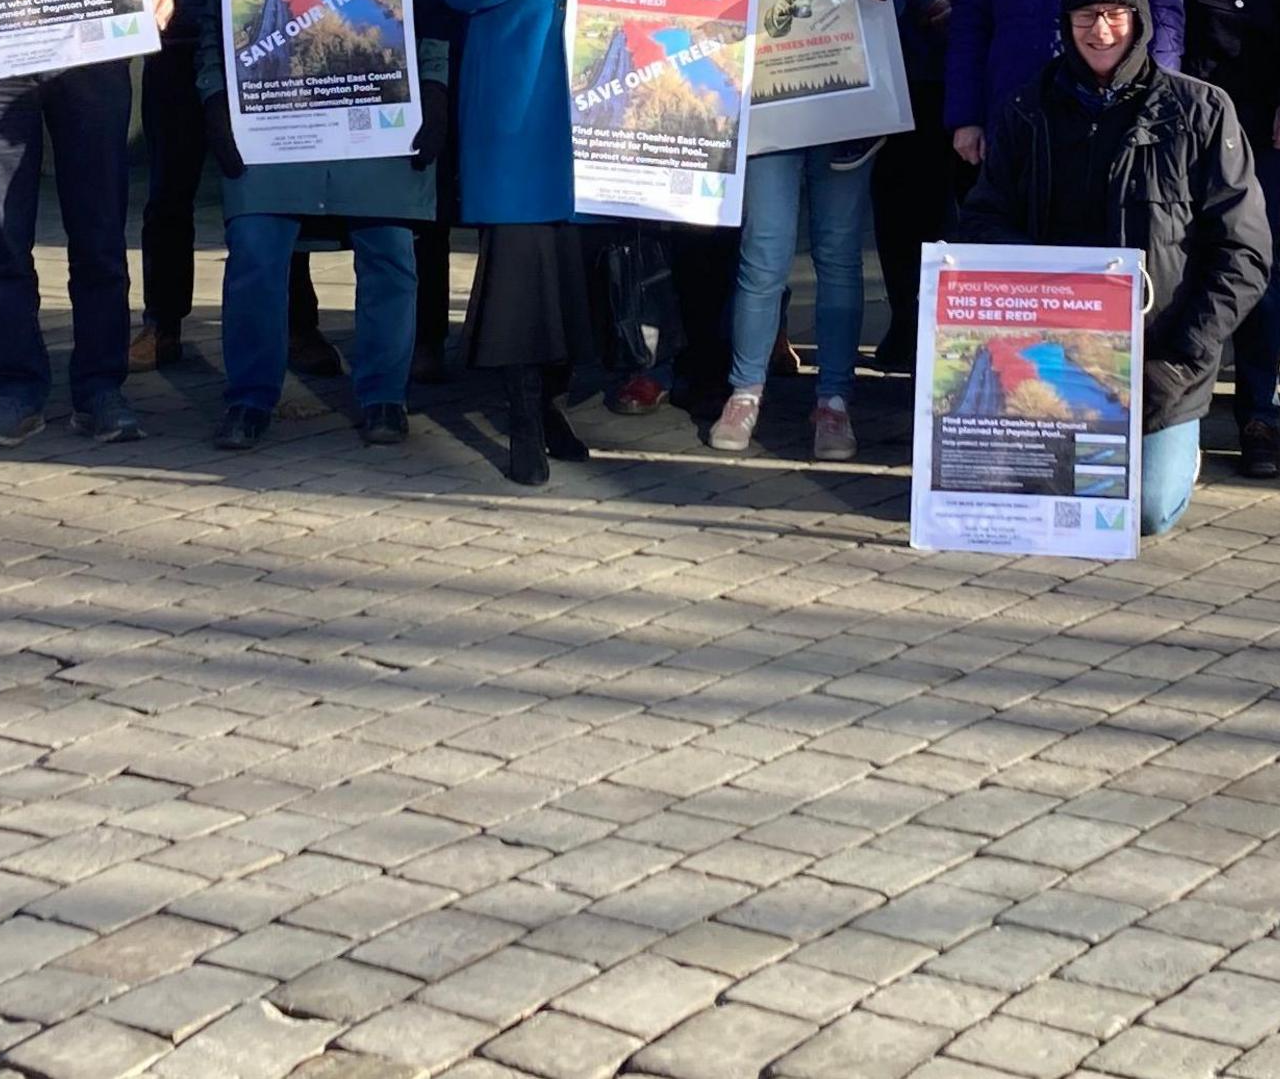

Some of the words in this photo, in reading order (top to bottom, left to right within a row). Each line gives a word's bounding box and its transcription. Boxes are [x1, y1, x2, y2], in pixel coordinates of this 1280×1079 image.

[9, 0, 32, 9] what
[27, 6, 41, 15] for
[43, 1, 82, 15] Poynton
[240, 30, 286, 67] SAVE
[285, 5, 325, 37] OUR
[242, 81, 262, 90] Find
[264, 80, 279, 88] out
[281, 78, 304, 87] what
[306, 76, 345, 86] Cheshire
[347, 74, 366, 82] East
[368, 70, 402, 81] Council
[574, 78, 624, 112] SAVE
[624, 60, 665, 89] OUR
[243, 91, 259, 100] has
[261, 89, 297, 100] planned
[299, 87, 312, 96] for
[314, 85, 352, 96] Poynton
[573, 126, 593, 136] Find
[594, 129, 610, 137] out
[611, 130, 635, 140] what
[637, 132, 675, 144] Cheshire
[677, 136, 696, 146] East
[698, 137, 732, 148] Council
[572, 136, 587, 146] has
[589, 138, 626, 149] planned
[628, 141, 641, 150] for
[643, 143, 680, 155] Poynton
[947, 281, 955, 290] If
[958, 283, 981, 294] you
[983, 282, 1009, 292] love
[1010, 285, 1039, 295] your
[1041, 284, 1075, 296] trees,
[947, 296, 977, 307] THIS
[980, 297, 992, 307] IS
[995, 298, 1039, 308] GOING
[1041, 299, 1060, 309] TO
[1063, 300, 1102, 311] MAKE
[946, 309, 974, 320] YOU
[978, 310, 1002, 320] SEE
[1005, 310, 1036, 321] RED!
